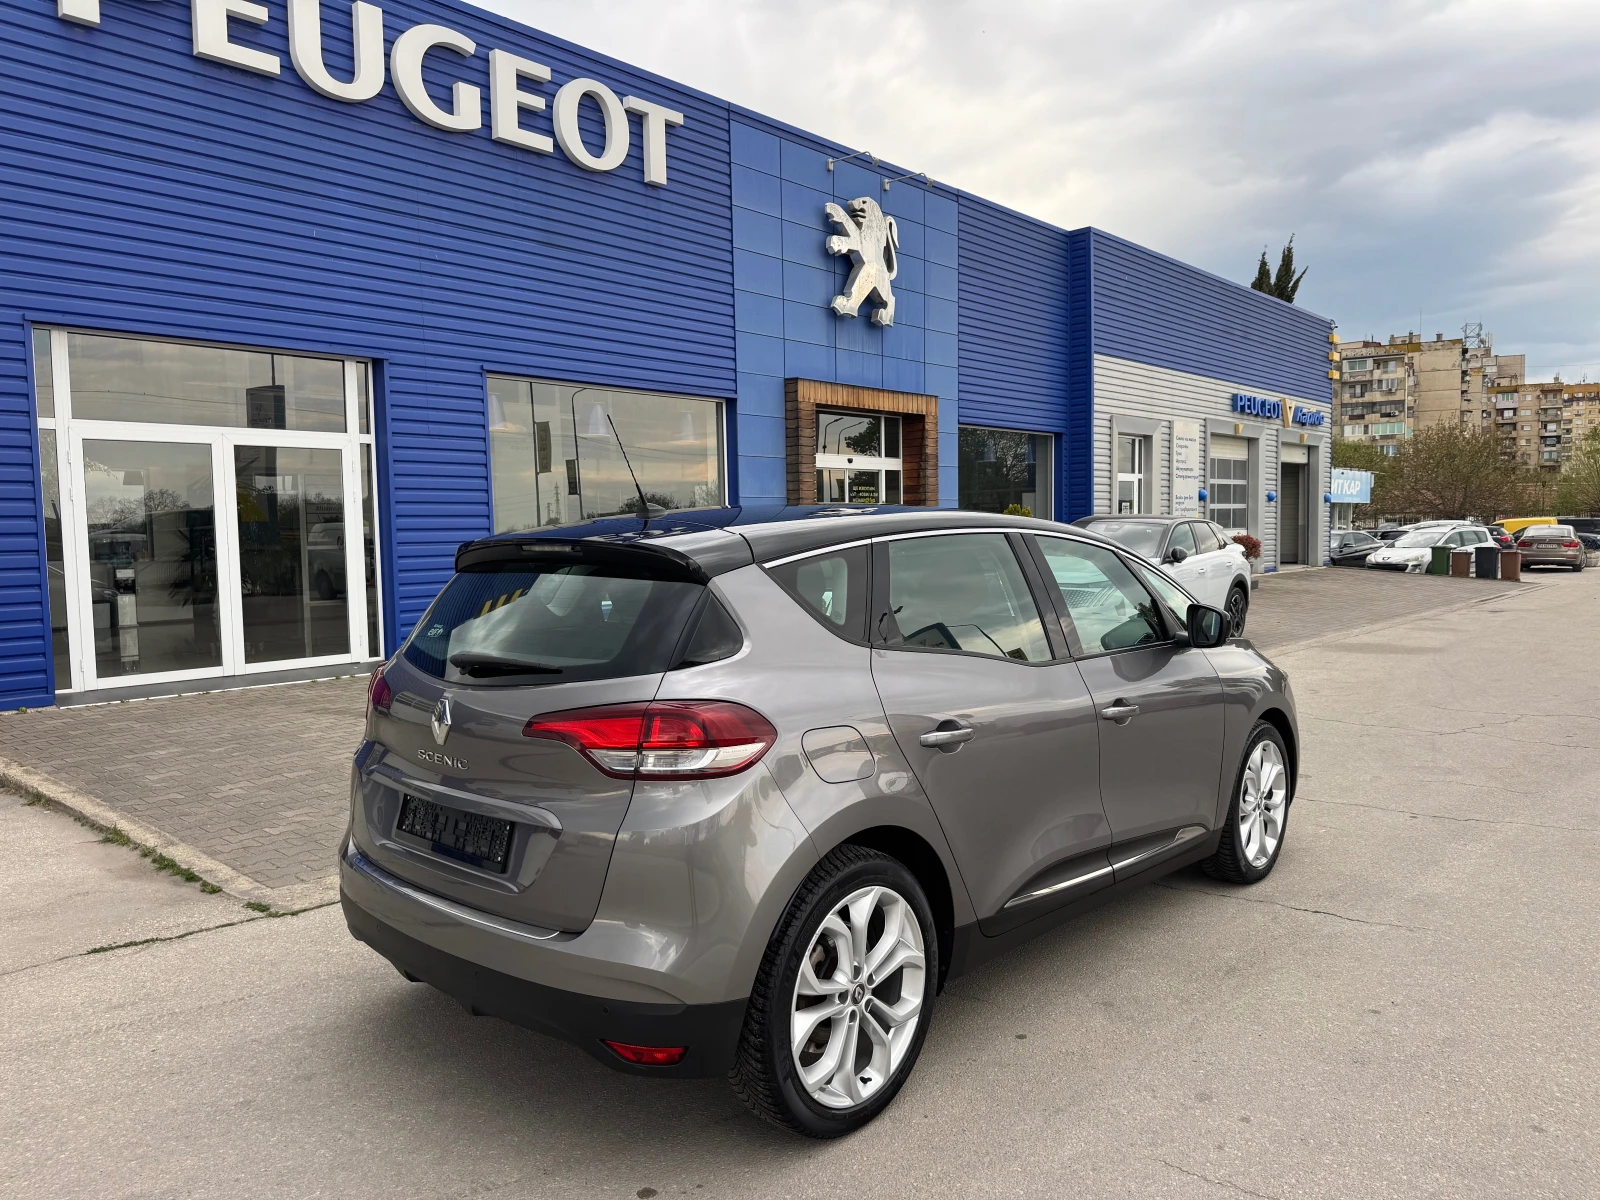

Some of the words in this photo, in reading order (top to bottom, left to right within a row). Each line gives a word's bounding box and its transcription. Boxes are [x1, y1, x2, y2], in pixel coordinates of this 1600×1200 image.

[57, 0, 684, 186] EUGEOT
[1233, 393, 1283, 419] PEUGEOT
[416, 748, 470, 771] SCENIC
